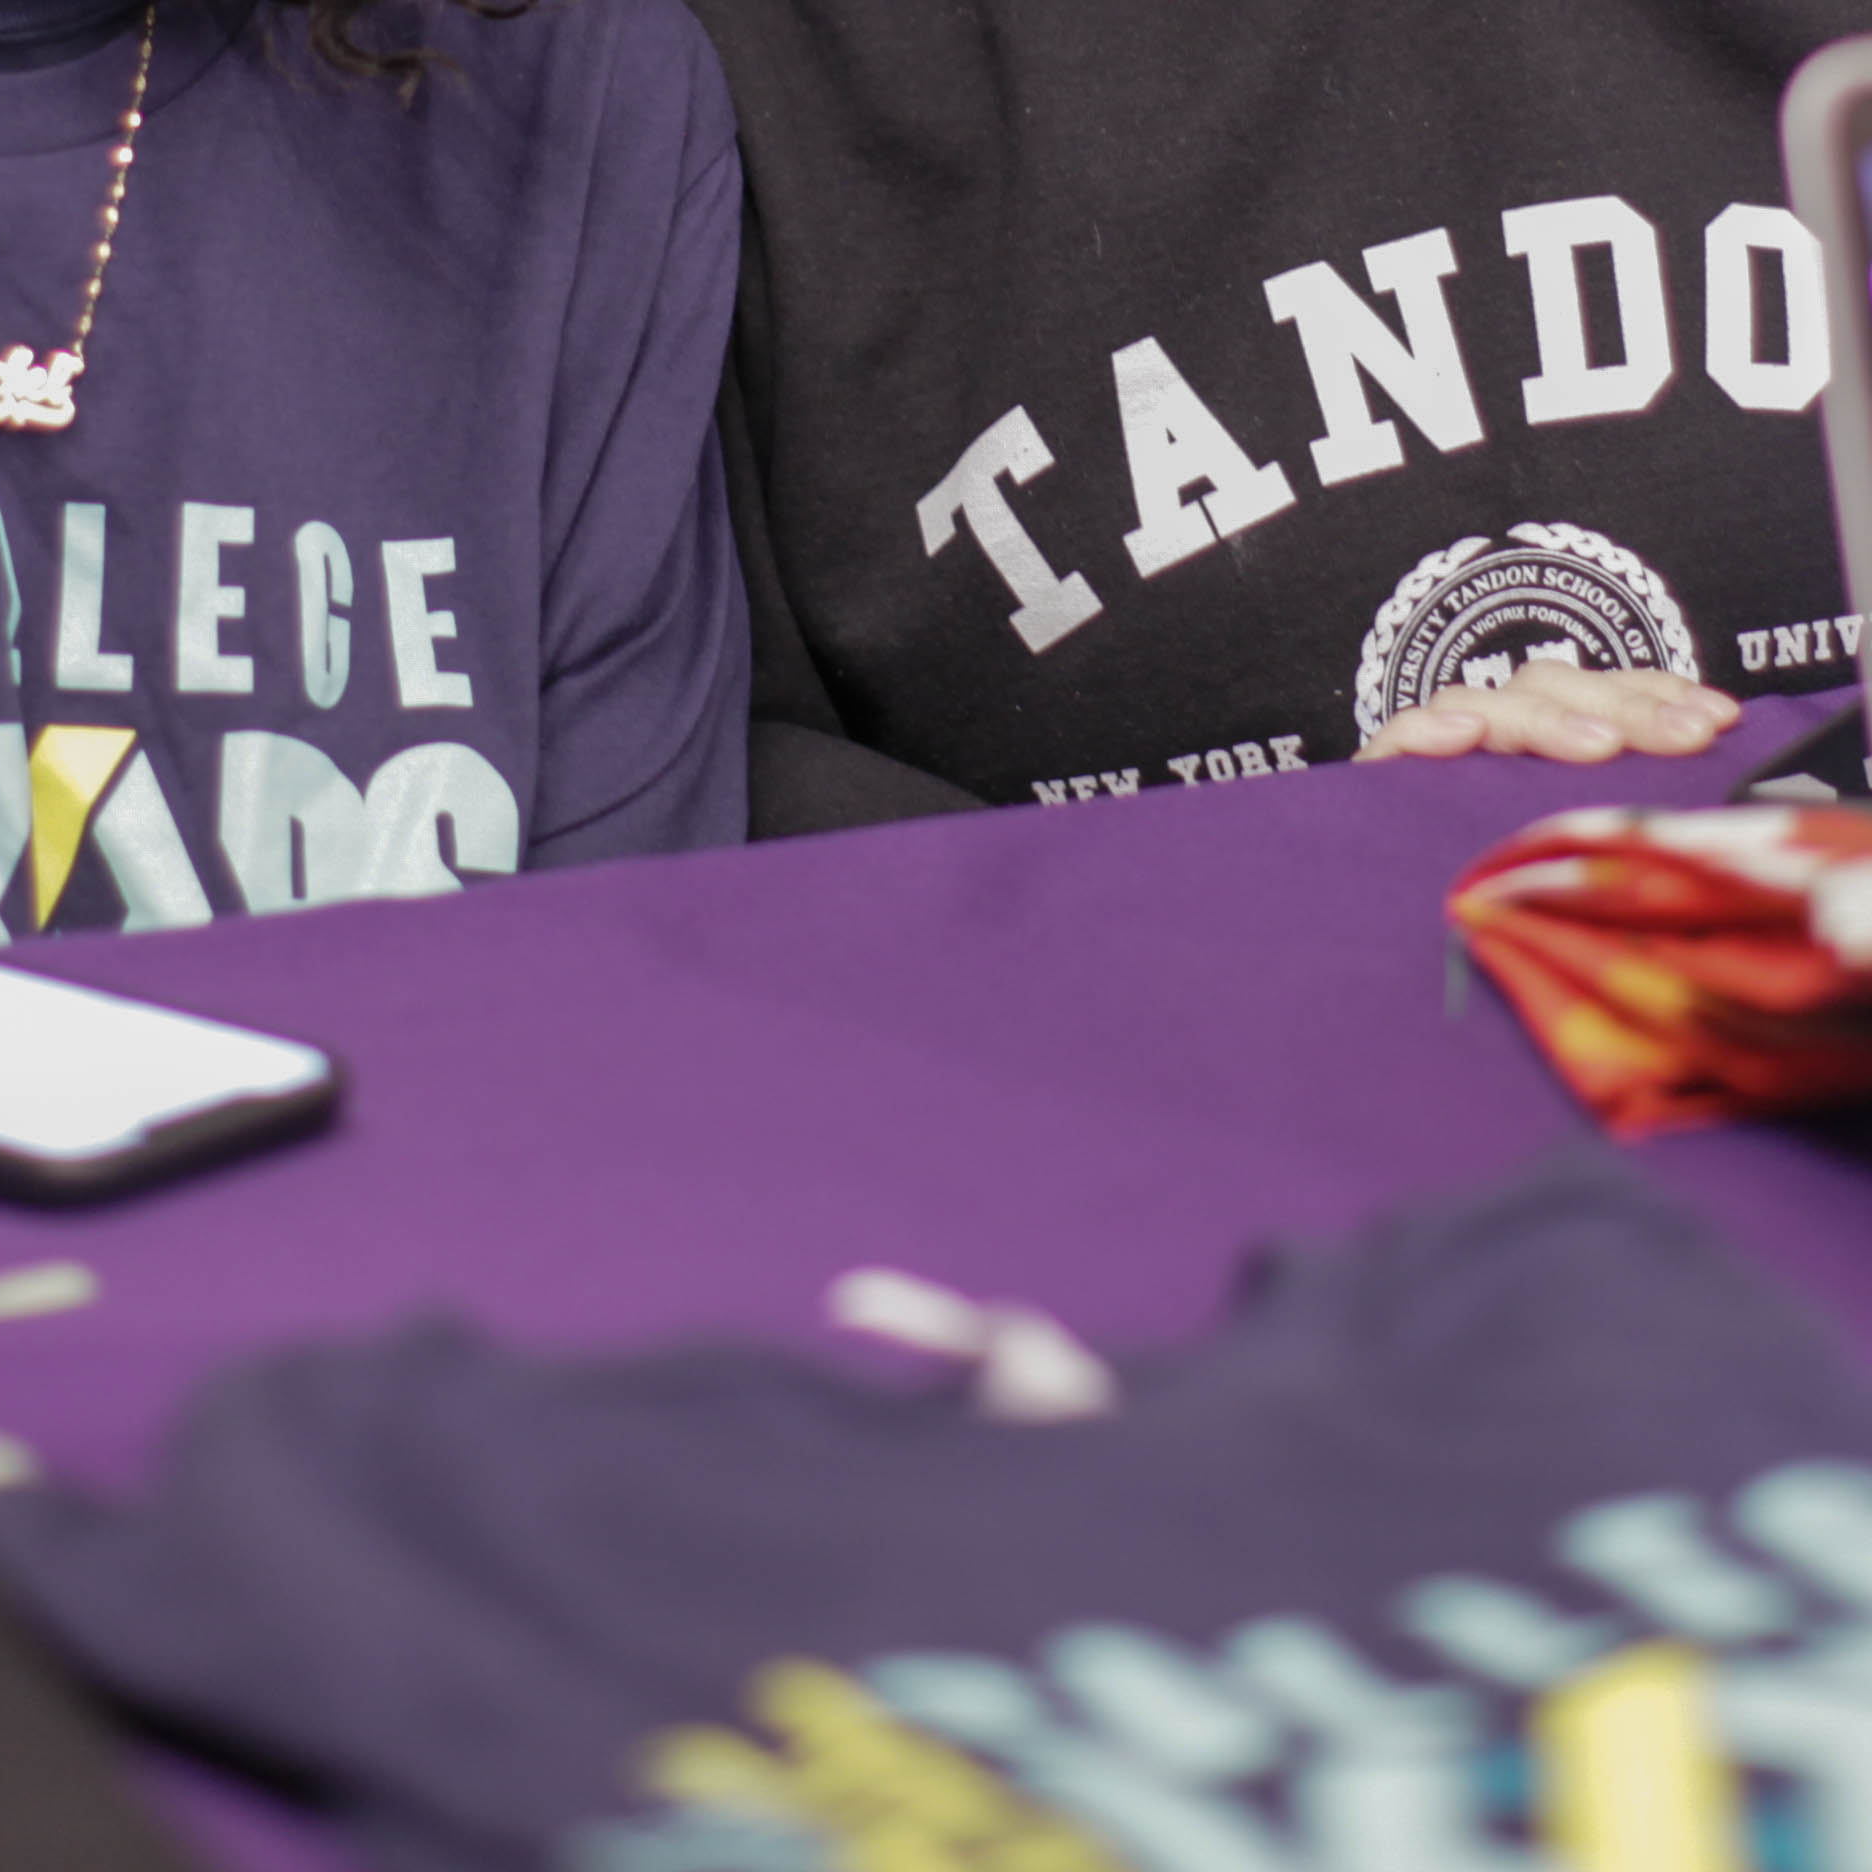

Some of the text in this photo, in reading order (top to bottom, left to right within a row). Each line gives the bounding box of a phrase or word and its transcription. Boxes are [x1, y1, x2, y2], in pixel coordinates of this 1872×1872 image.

[916, 195, 1833, 655] TANDO
[1395, 564, 1653, 709] VERSITY TANDON SCHOOL OF
[1437, 630, 1476, 684] VIRTUS
[1471, 605, 1526, 636] VICTRIX
[1166, 733, 1310, 789] YORK
